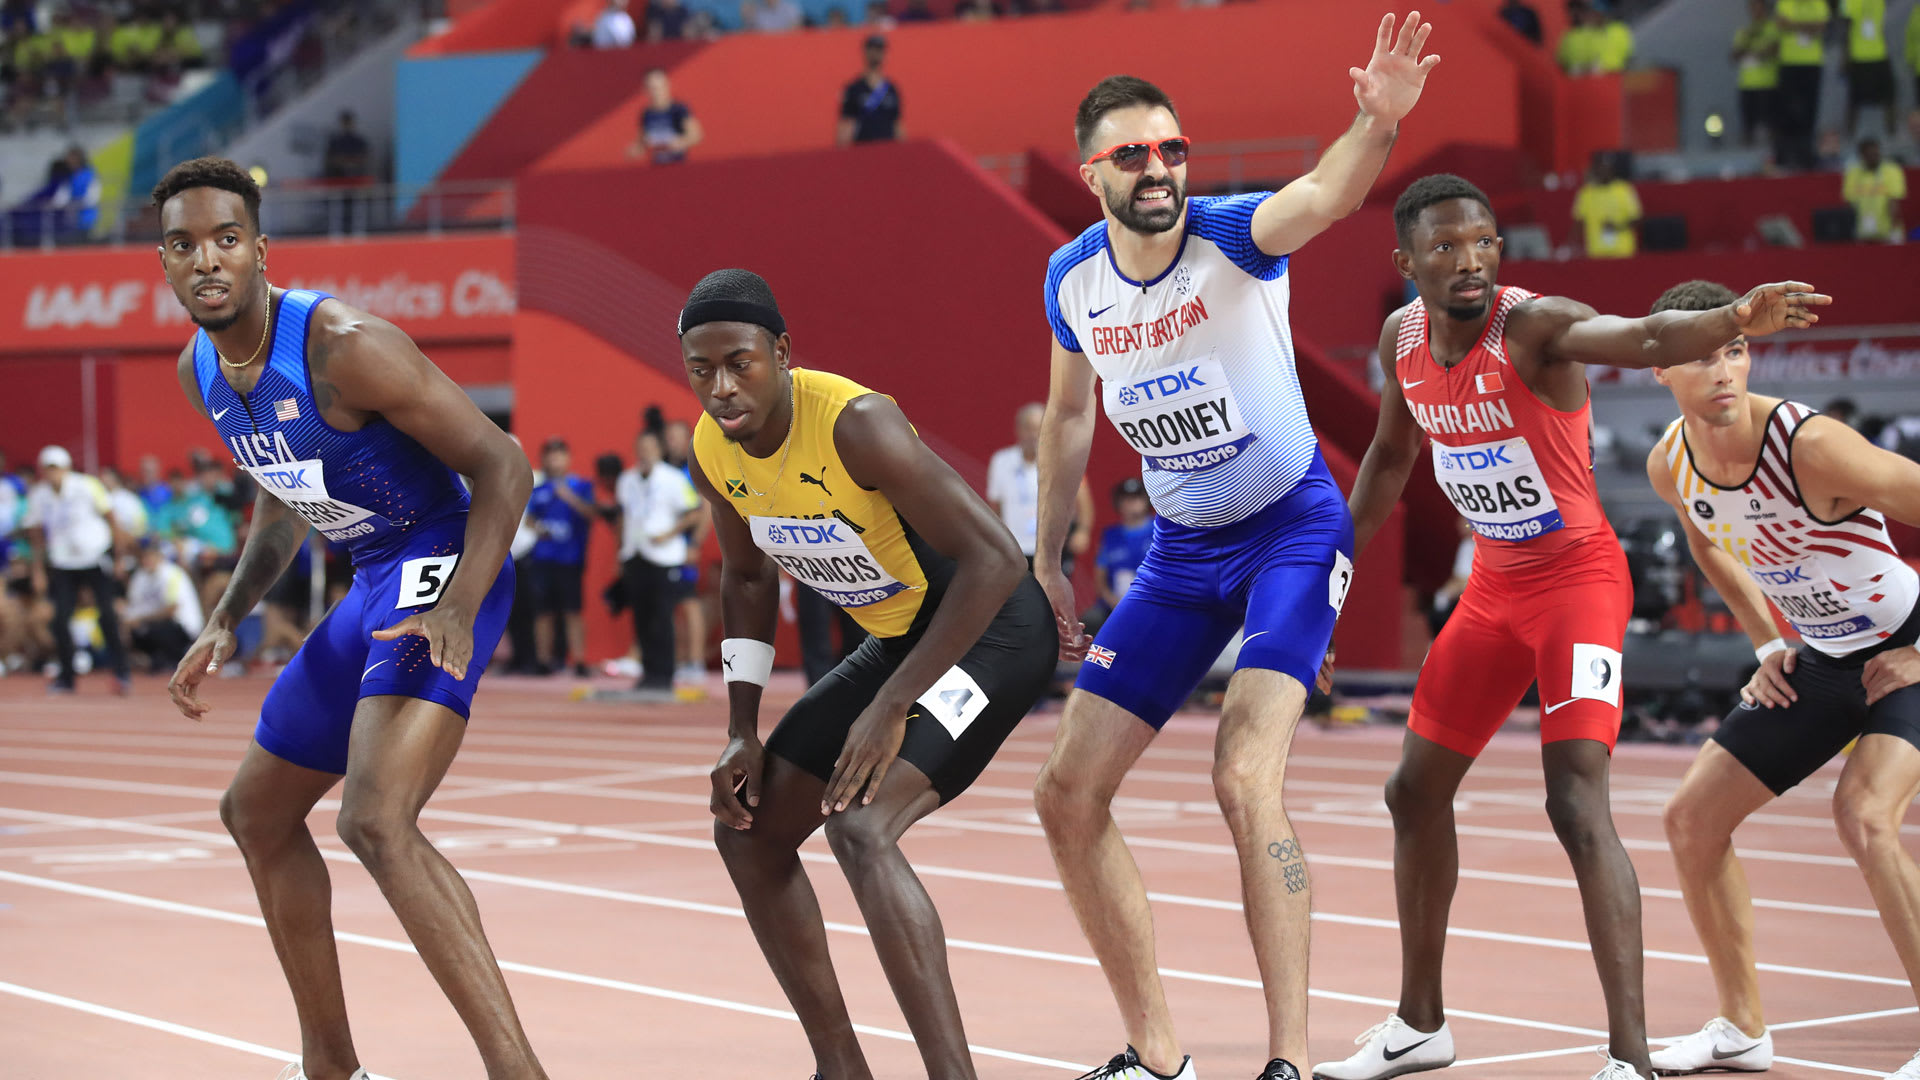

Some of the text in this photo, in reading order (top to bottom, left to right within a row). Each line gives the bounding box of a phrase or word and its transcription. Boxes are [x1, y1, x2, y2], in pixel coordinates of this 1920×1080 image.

[25, 283, 146, 329] IAAF
[1092, 295, 1209, 356] GREAT BRITAIN
[1134, 366, 1206, 400] TDK
[1119, 397, 1232, 449] ROONEY
[230, 430, 298, 467] USA
[1156, 444, 1238, 471] DOHA2019
[1450, 445, 1513, 470] TDK
[263, 469, 312, 489] TDK
[1445, 475, 1541, 513] ABBAS
[287, 499, 355, 524] ERRY
[781, 524, 845, 544] TDK
[416, 564, 442, 598] 5
[773, 554, 882, 584] FRANCIS
[1755, 565, 1812, 585] TDK
[1590, 657, 1612, 690] 9
[938, 688, 973, 717] 4
